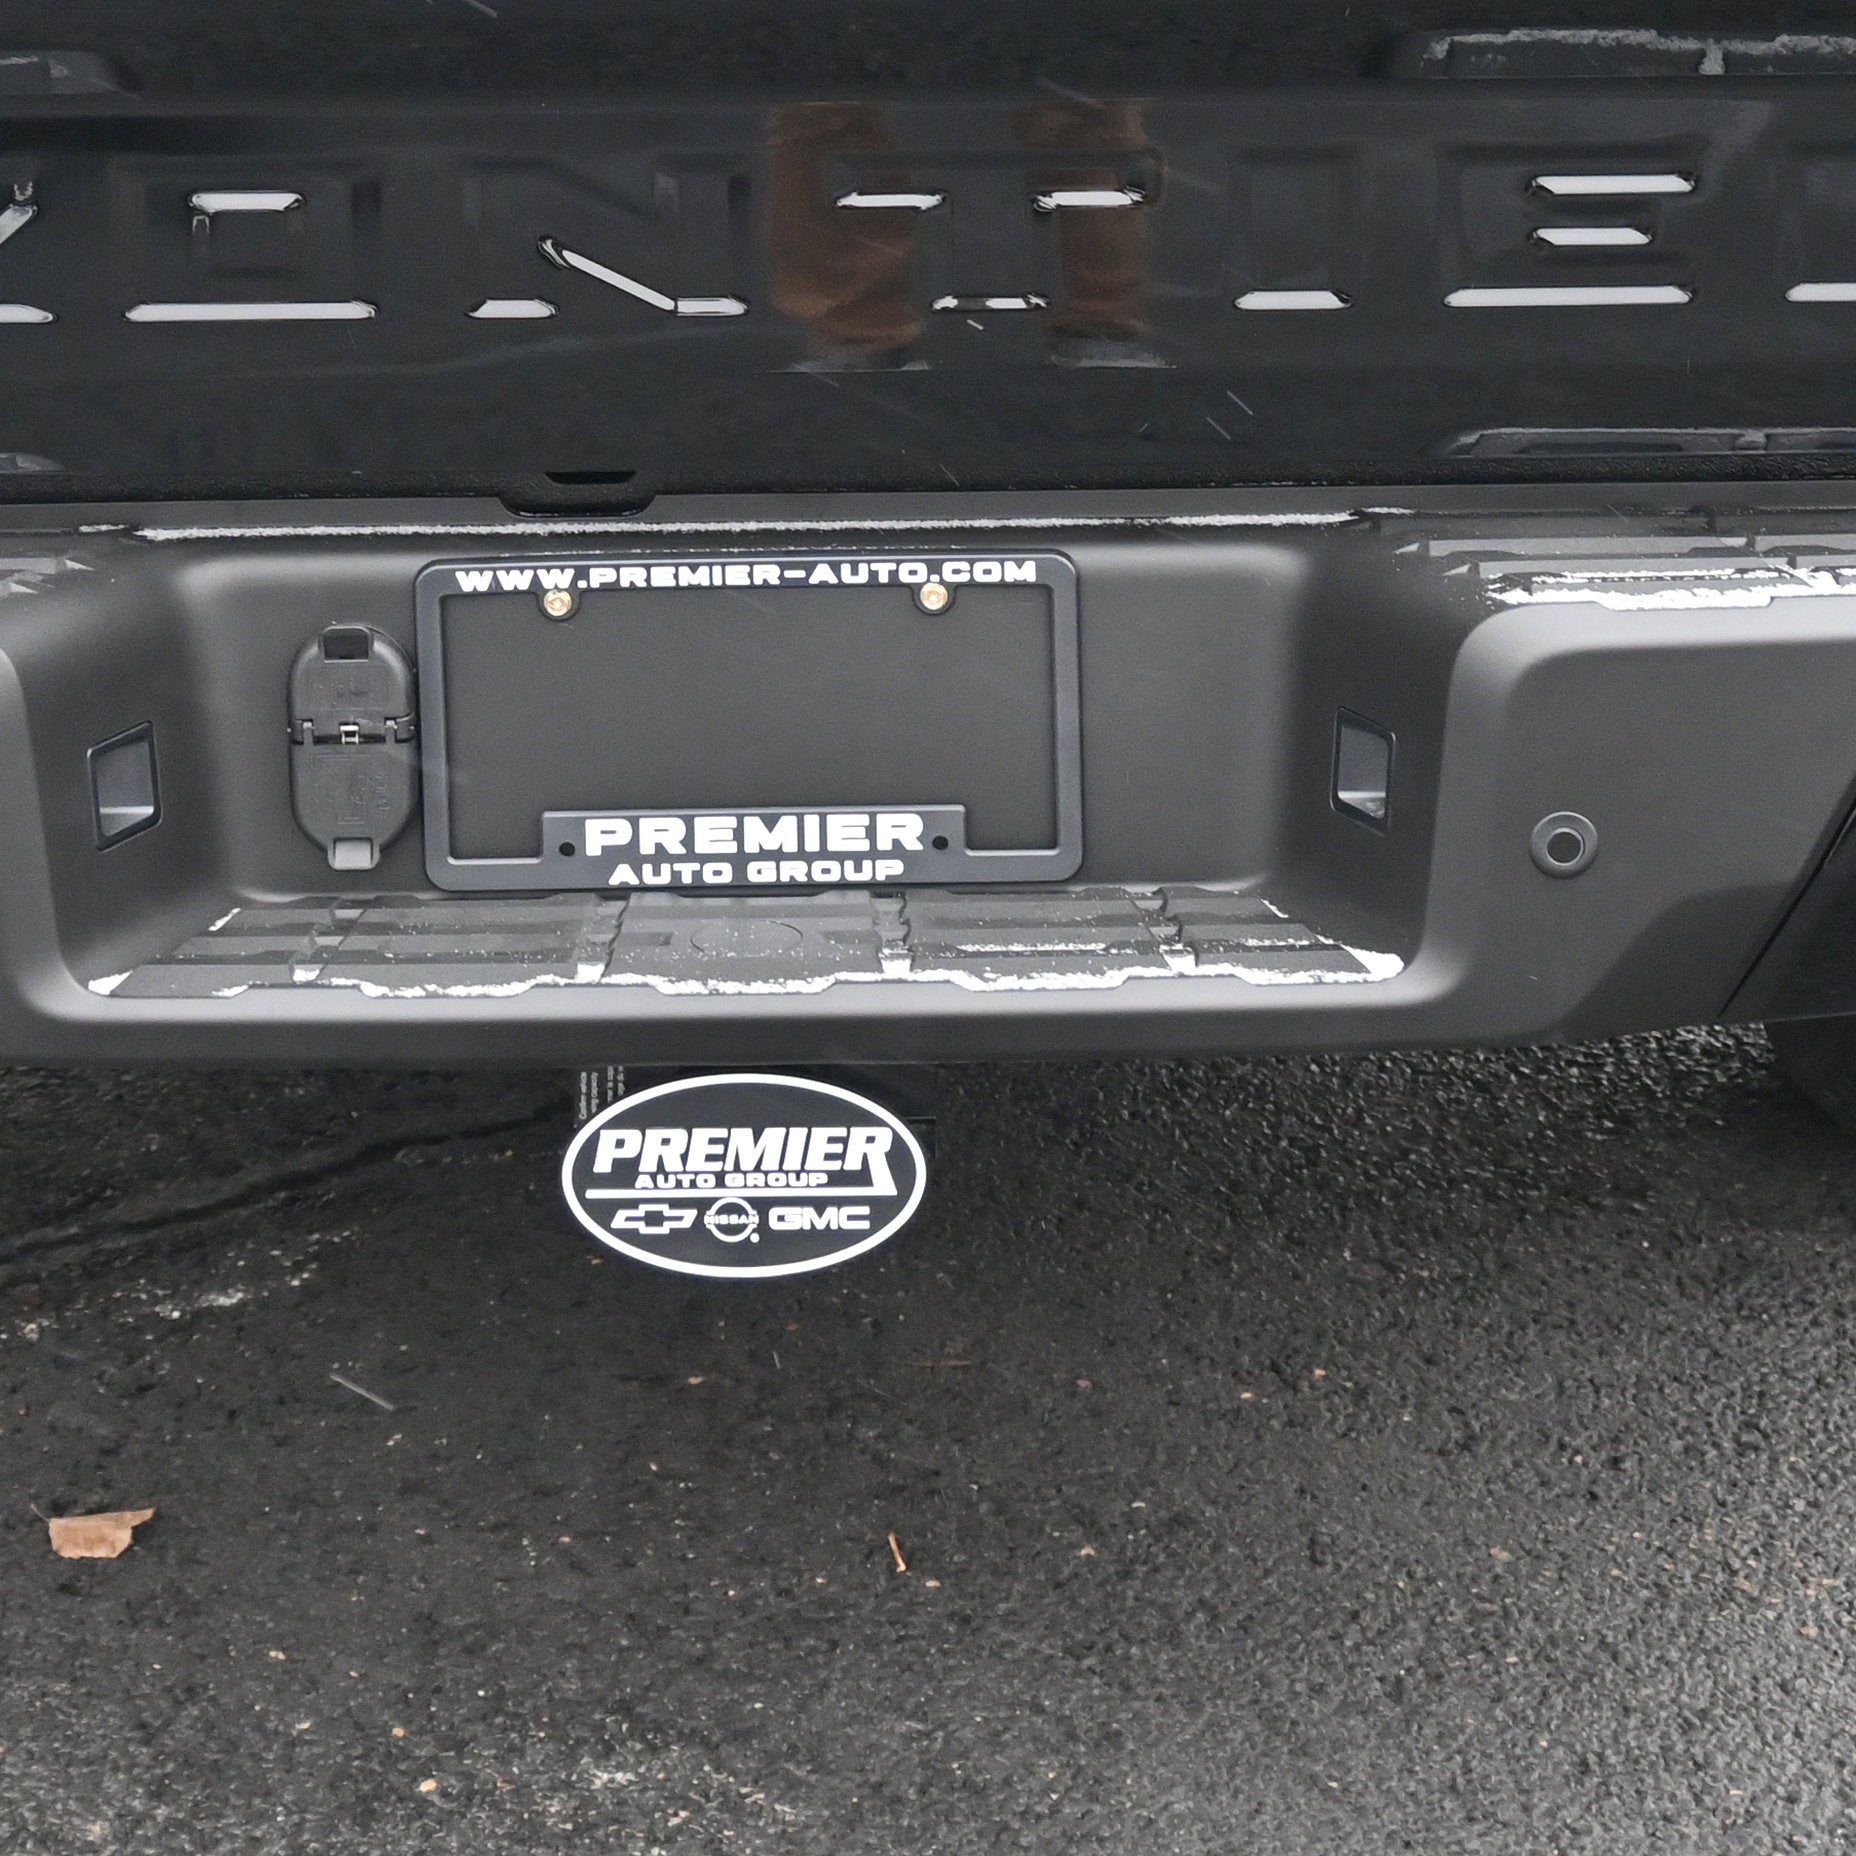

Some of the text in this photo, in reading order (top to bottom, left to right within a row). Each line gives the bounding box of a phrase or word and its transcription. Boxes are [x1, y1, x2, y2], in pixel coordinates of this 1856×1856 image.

[453, 560, 1037, 593] WWW.PREMIER-AUTO.COM
[582, 812, 925, 857] PREMIER
[607, 858, 906, 887] AUTO GROUP
[591, 1126, 898, 1175] PREMIER
[633, 1172, 830, 1190] AUTO GROUP
[703, 1205, 871, 1231] NISSAN GMC
